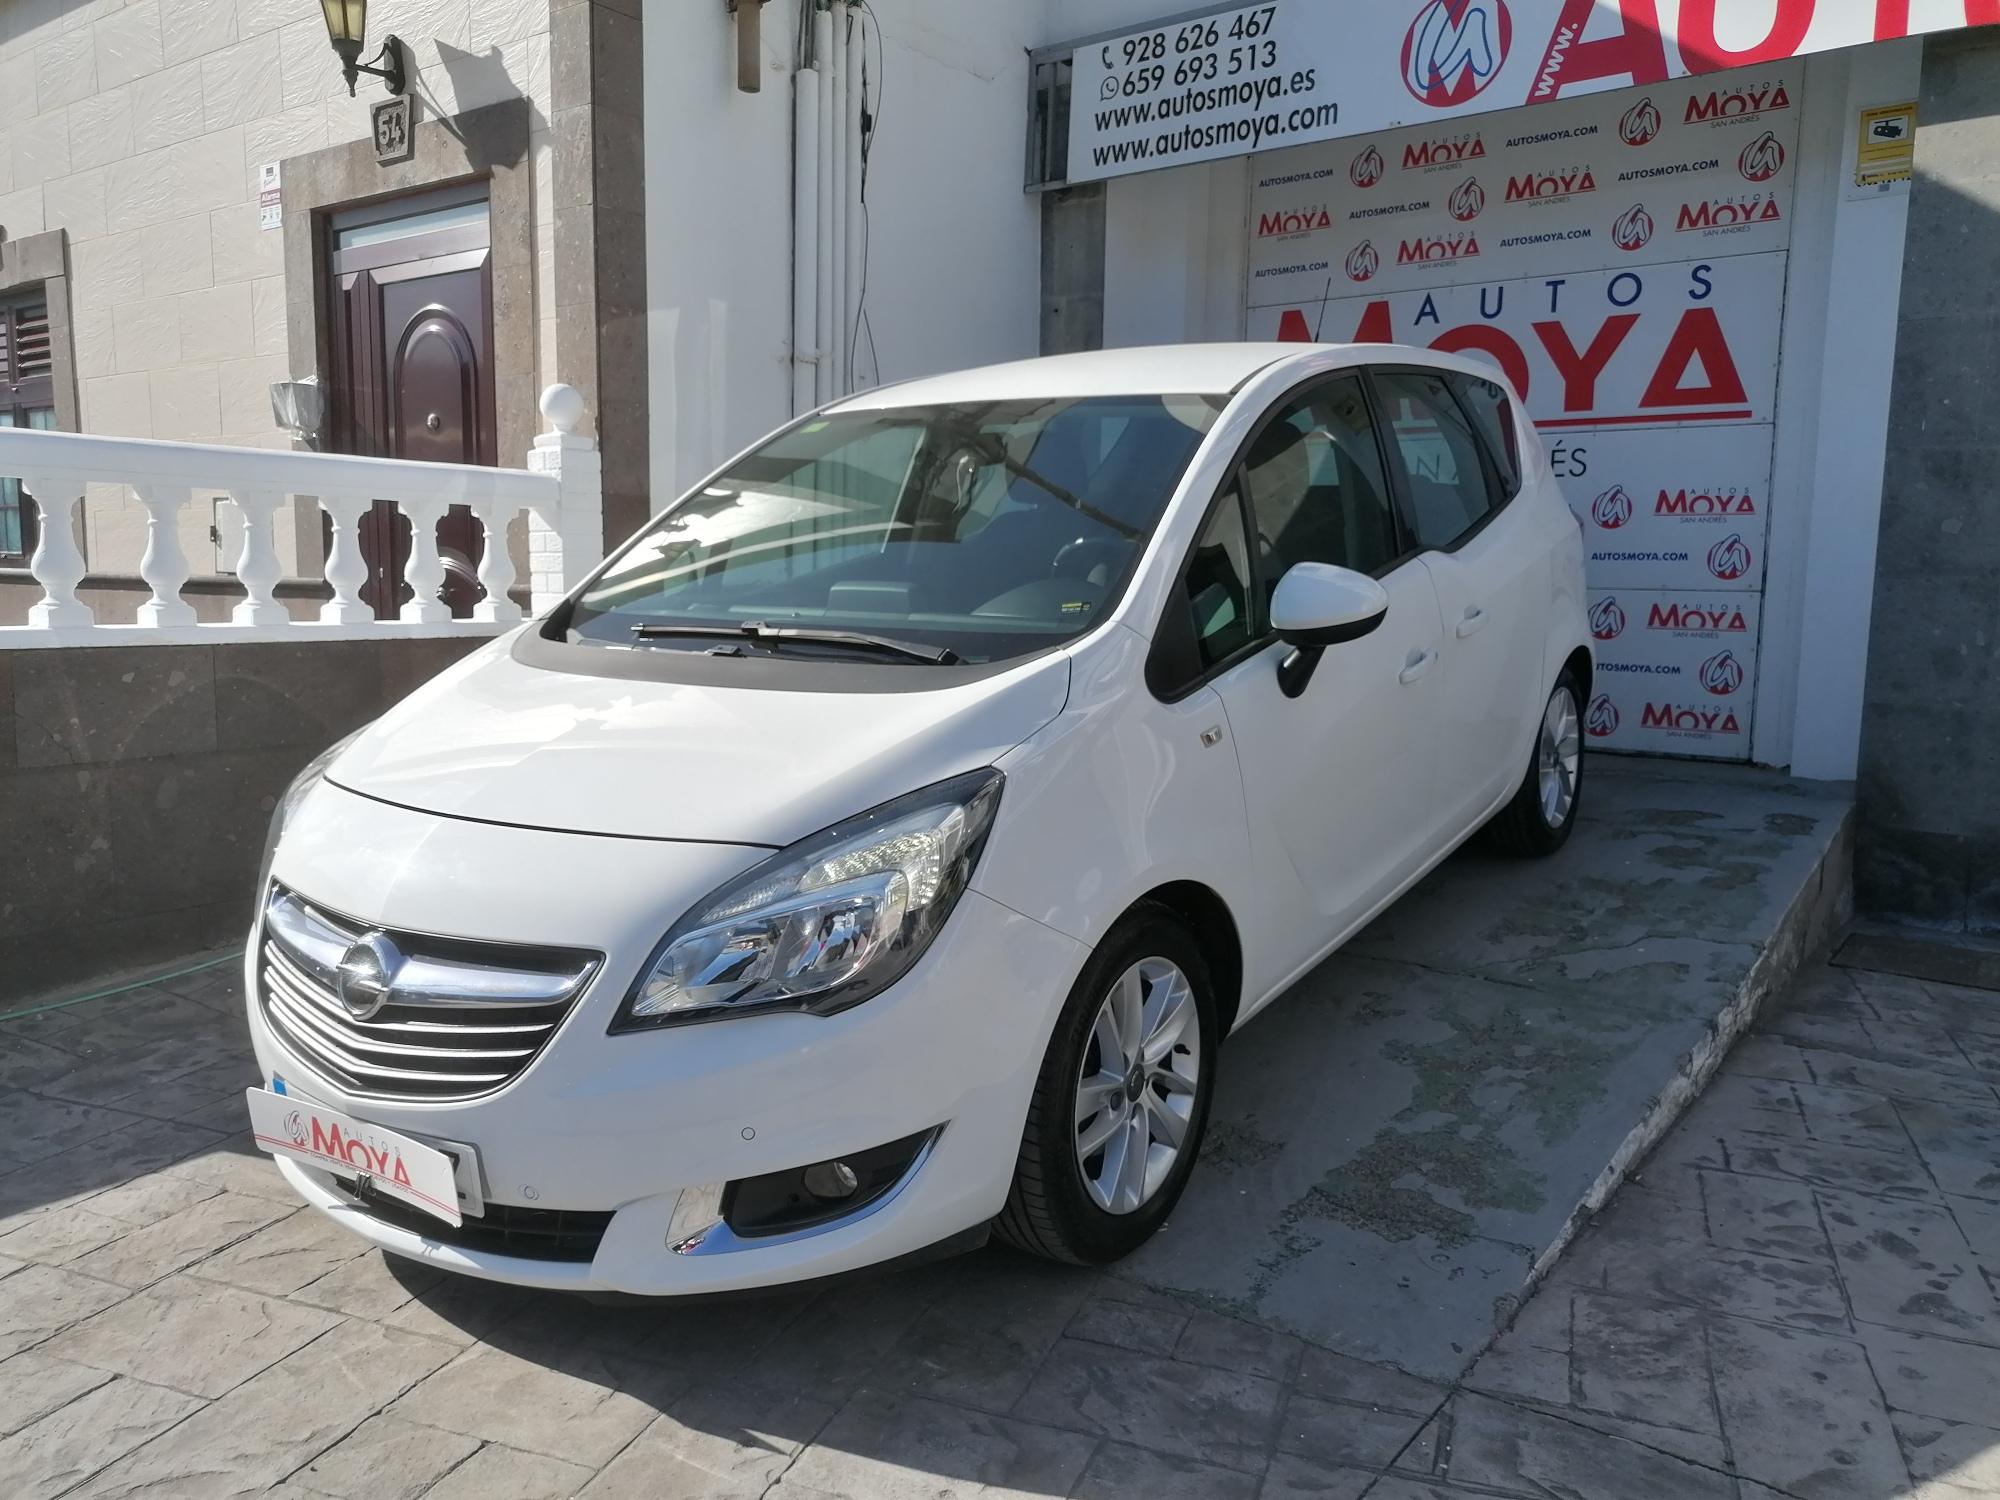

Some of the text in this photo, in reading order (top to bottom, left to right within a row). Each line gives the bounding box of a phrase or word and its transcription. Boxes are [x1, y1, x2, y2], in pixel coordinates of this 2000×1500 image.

[1122, 6, 1277, 66] 928 626 467
[1122, 40, 1277, 97] 659 693 513
[1534, 22, 1579, 98] www.
[1722, 79, 1784, 96] AUTOS
[1094, 68, 1316, 132] www.autosmoya.es
[1684, 87, 1790, 123] MOYA
[379, 111, 402, 146] 54
[1092, 102, 1339, 167] www.autosmoya.com
[1431, 132, 1481, 146] AUTOS
[1505, 125, 1599, 148] AUTOSMOYA.COM
[1402, 138, 1487, 168] MOYA
[1258, 169, 1334, 189] AUTOSMOYA.COM
[1537, 164, 1591, 178] AUTOS
[1617, 159, 1719, 182] AUTOSMOYA.COM
[1504, 172, 1597, 201] MOYA
[1284, 204, 1328, 215] AUTOS
[1349, 201, 1430, 220] AUTOSMOYA.COM
[1712, 191, 1775, 207] AUTOS
[1258, 211, 1331, 236] MOYA
[1676, 199, 1781, 230] MOYA
[1426, 230, 1475, 242] AUTOS
[1499, 228, 1592, 248] AUTOSMOYA.COM
[1397, 237, 1480, 264] MOYA
[1255, 261, 1328, 279] AUTOSMOYA.COM
[1413, 264, 1713, 326] AUTOS
[1654, 489, 1755, 513] MOYA
[1690, 487, 1750, 495] AUTOS
[1591, 552, 1688, 561] AUTOSMOYA.COM
[1647, 603, 1747, 629] MOYA
[1640, 702, 1740, 732] MOYA
[1675, 704, 1734, 713] AUTOS
[312, 1116, 412, 1187] MOYA
